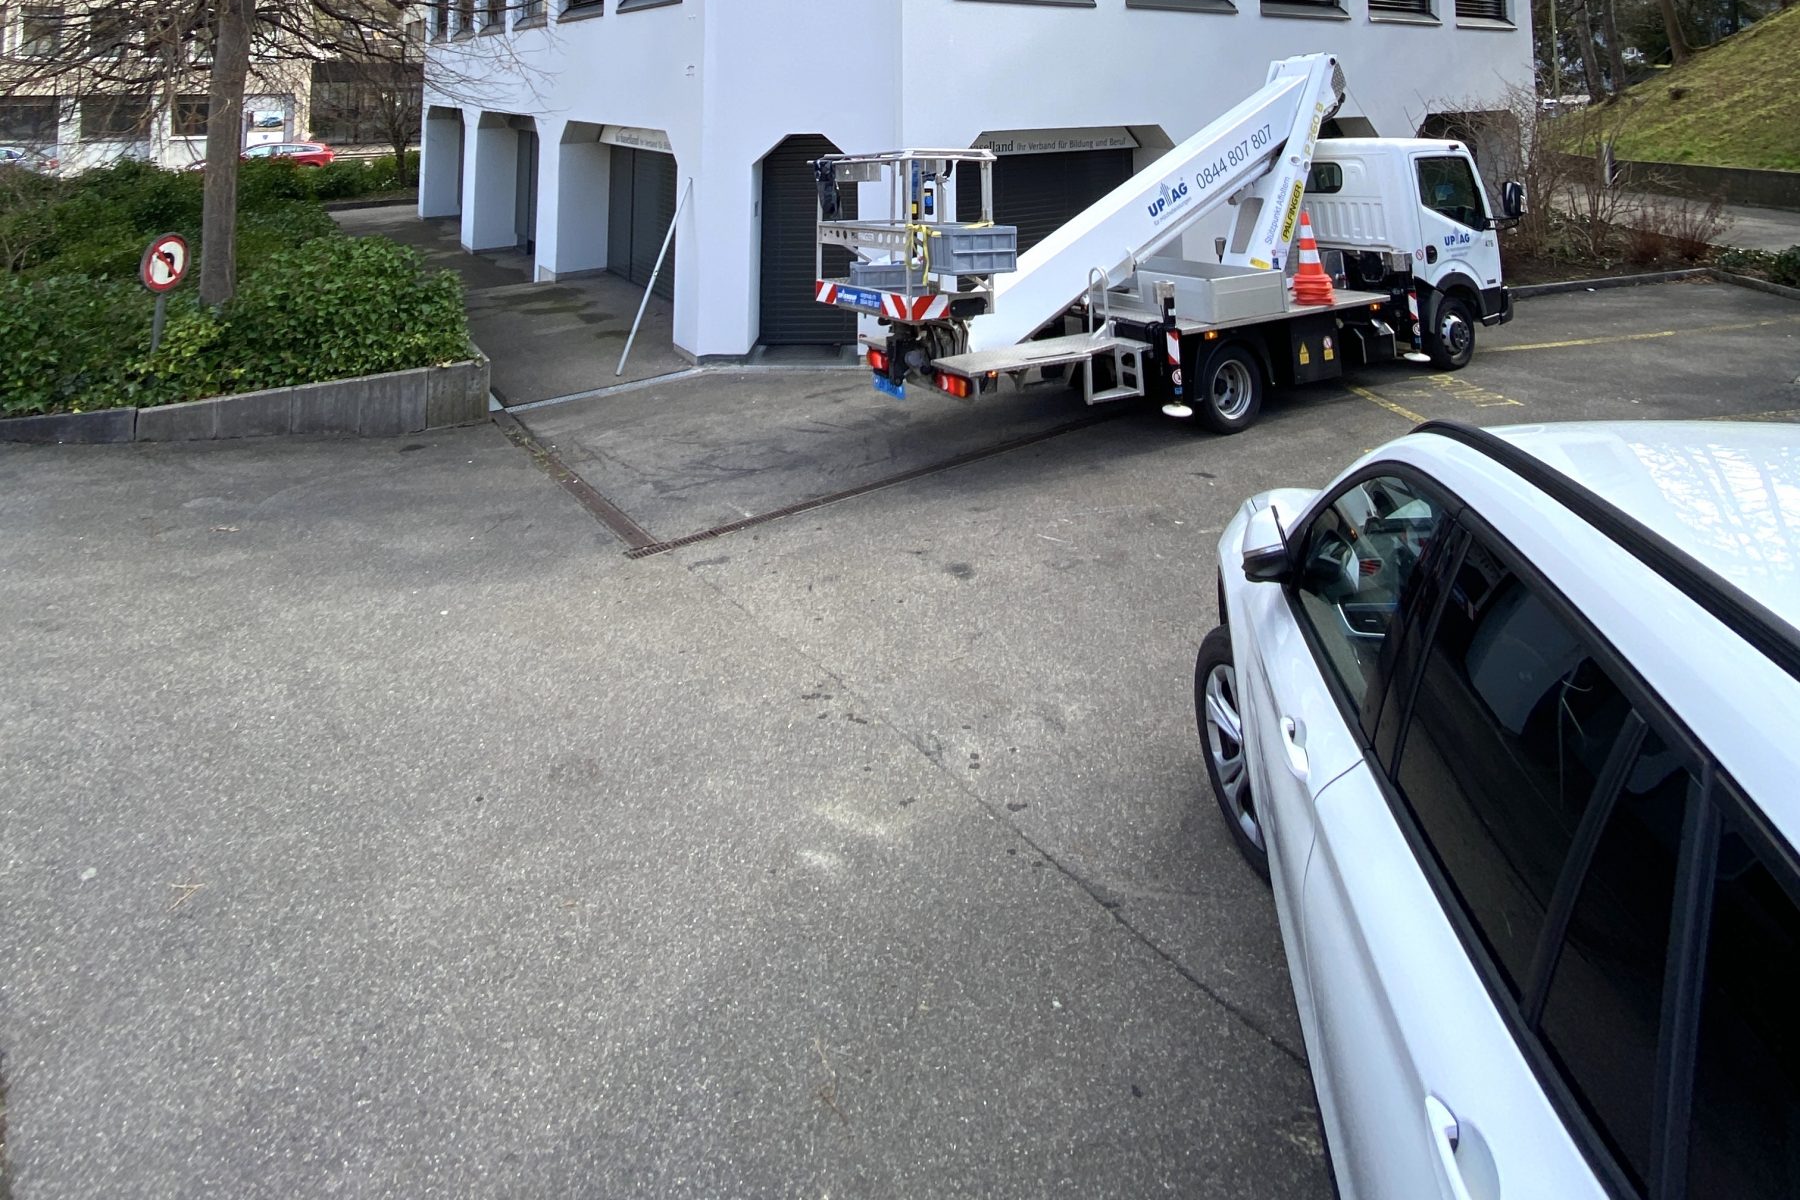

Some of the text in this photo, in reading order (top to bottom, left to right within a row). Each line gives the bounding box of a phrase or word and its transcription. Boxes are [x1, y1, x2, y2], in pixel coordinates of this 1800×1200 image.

[1029, 141, 1055, 150] Verband
[1058, 140, 1068, 149] für
[1070, 139, 1094, 149] Bildung
[1096, 139, 1107, 147] und
[1109, 137, 1126, 146] Beruf
[1196, 124, 1272, 189] 0844 807 807
[1282, 184, 1302, 239] PALFINGER
